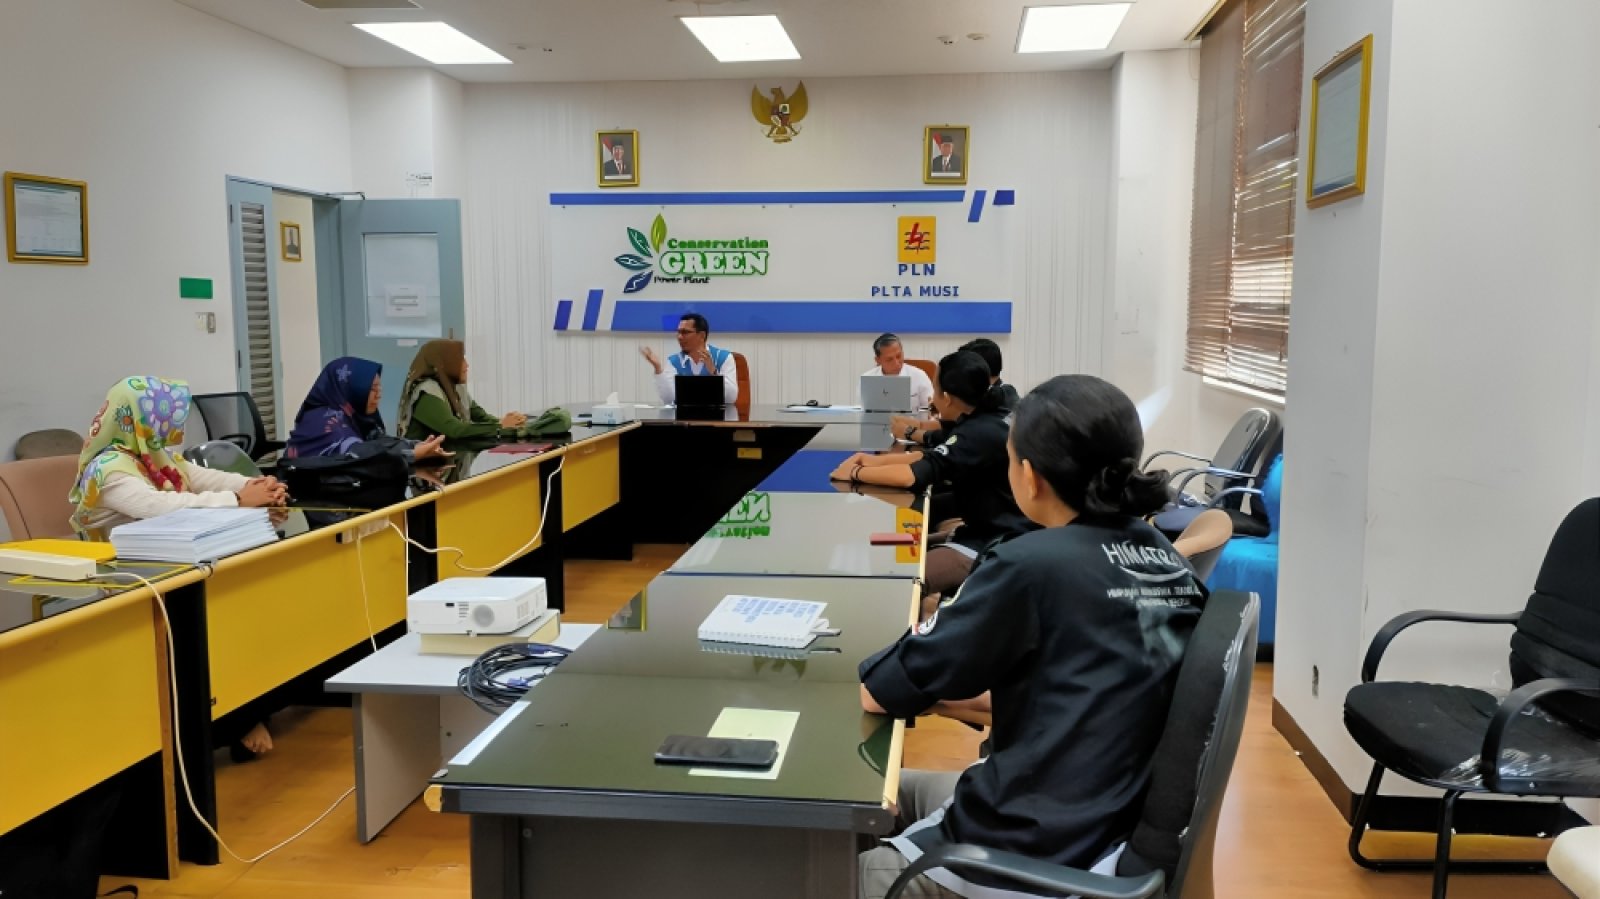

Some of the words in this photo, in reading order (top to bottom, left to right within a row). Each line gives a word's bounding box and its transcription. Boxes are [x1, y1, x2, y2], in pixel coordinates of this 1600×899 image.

[667, 237, 769, 249] Conservation
[659, 250, 769, 275] GREEN
[898, 263, 935, 276] PLN
[684, 276, 710, 284] Plant
[871, 285, 912, 297] PLTA
[919, 285, 959, 297] MUSI
